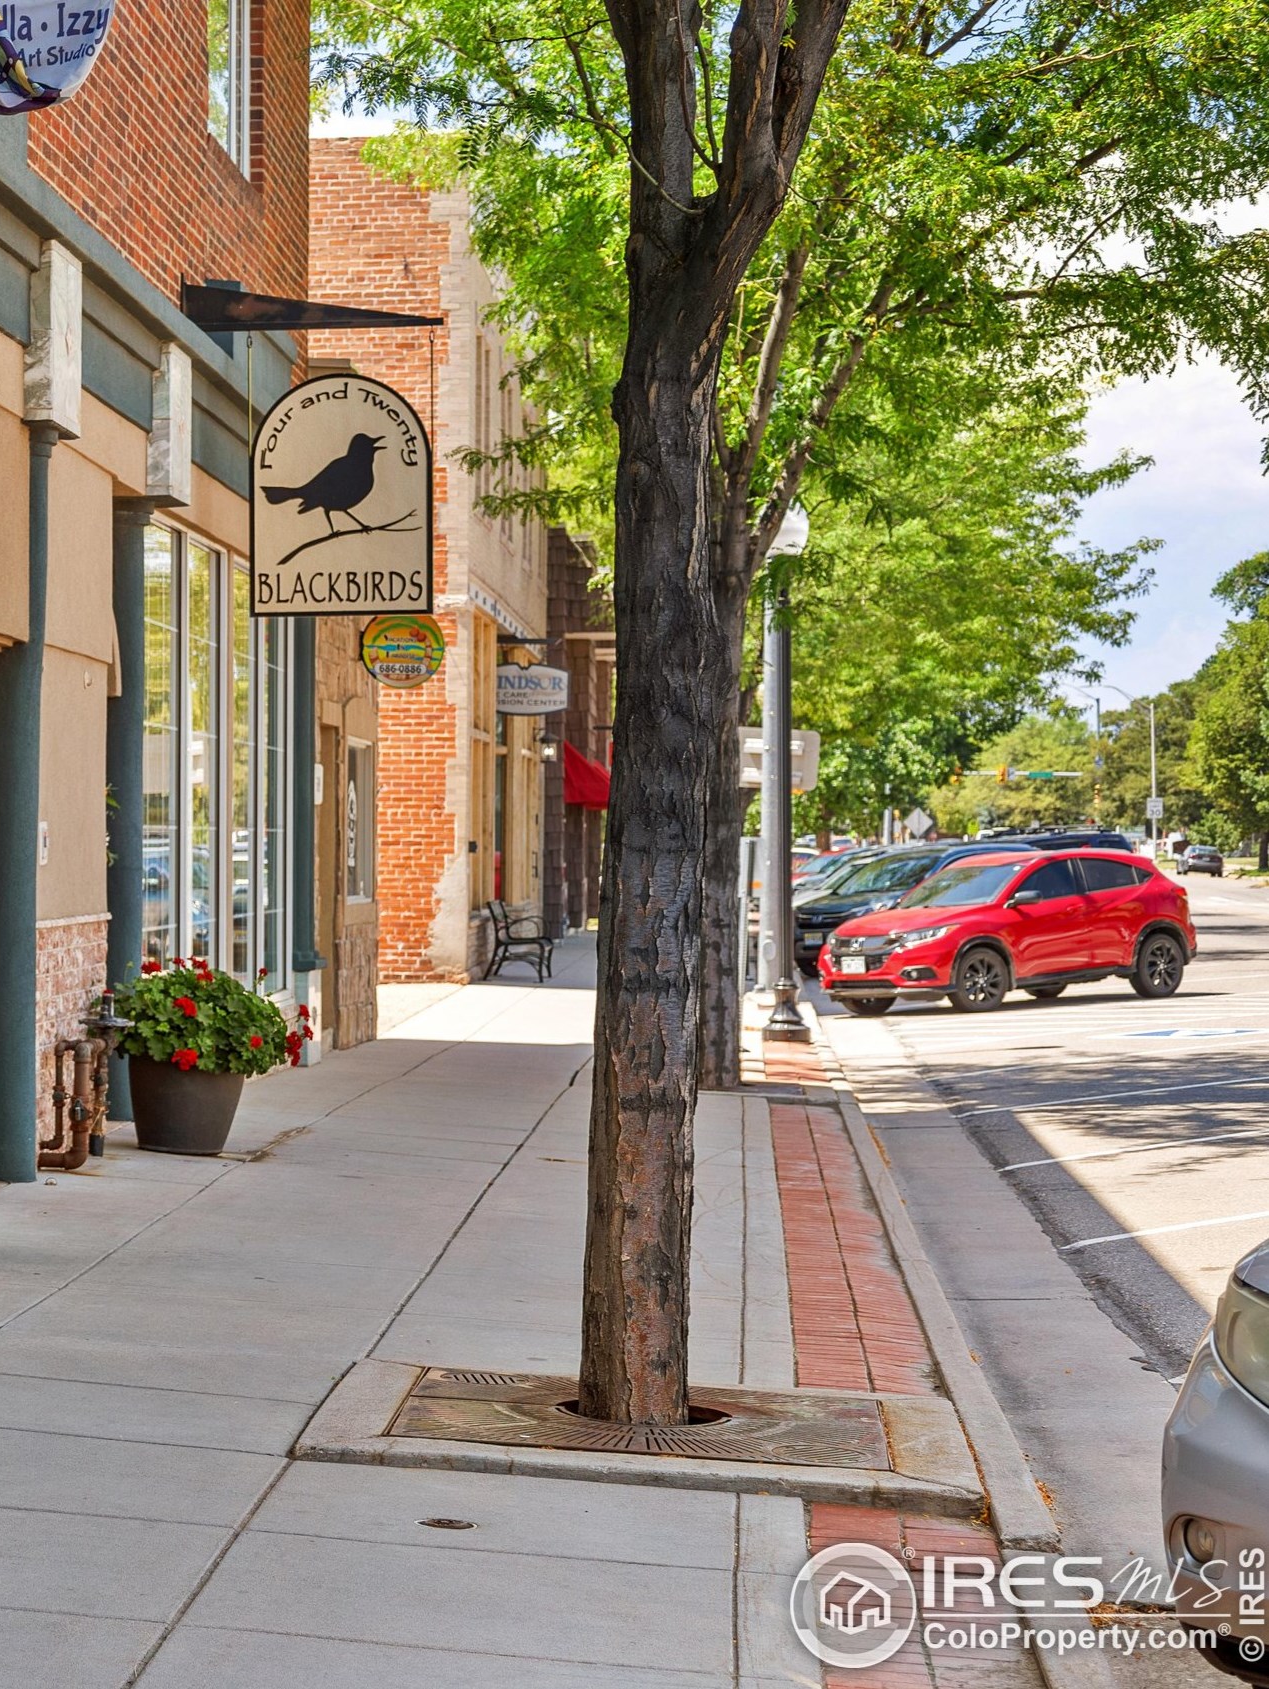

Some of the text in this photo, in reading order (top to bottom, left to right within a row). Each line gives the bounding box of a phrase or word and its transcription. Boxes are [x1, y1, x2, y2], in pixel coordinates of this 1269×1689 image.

[2, 3, 110, 44] lla Izzy
[17, 43, 96, 68] Art Studio
[260, 382, 418, 470] Four and Twenty
[257, 571, 423, 604] BLACKBIRDS
[379, 664, 422, 674] 686-0886
[497, 676, 563, 690] INDSOR
[527, 699, 566, 707] CENTER
